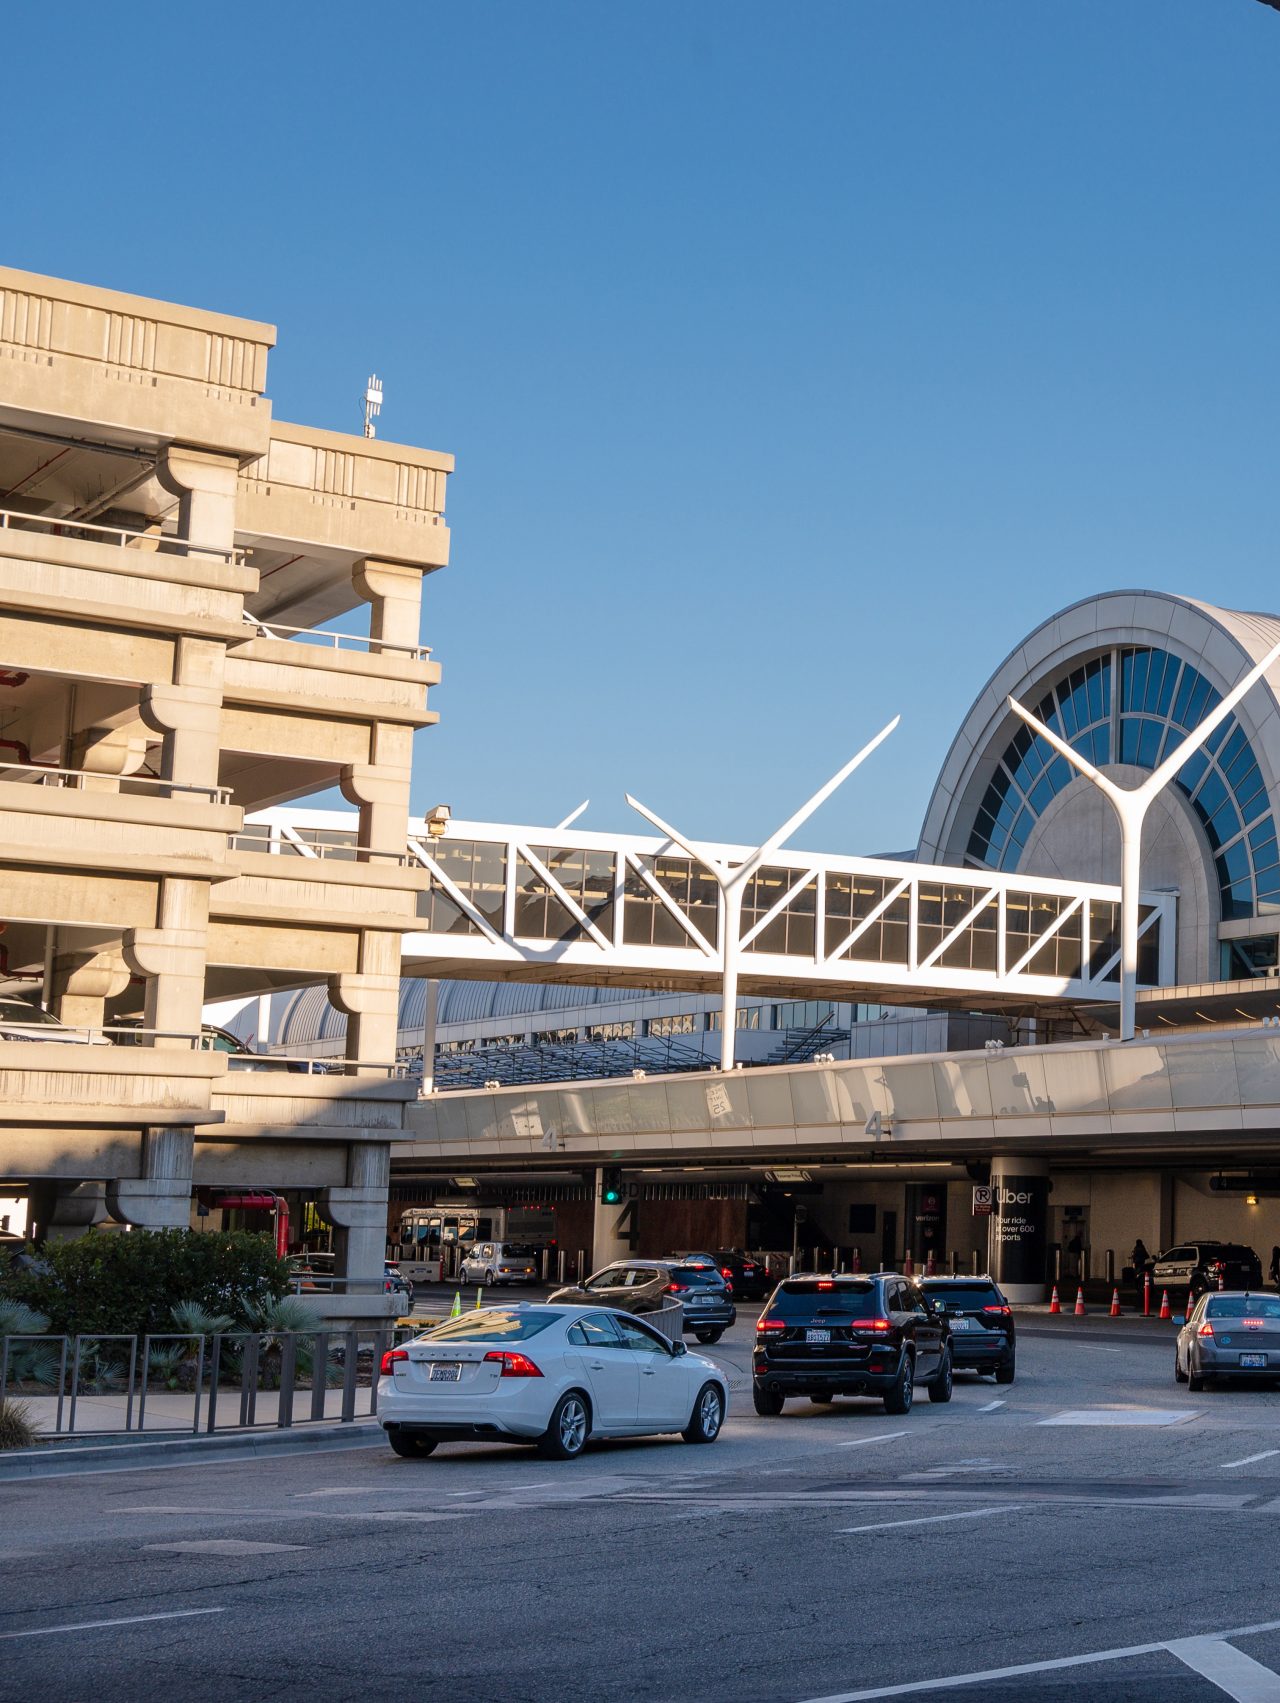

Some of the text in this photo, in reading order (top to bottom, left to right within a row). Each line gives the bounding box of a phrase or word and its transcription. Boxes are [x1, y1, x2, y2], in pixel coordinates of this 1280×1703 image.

[865, 1110, 882, 1142] 4
[541, 1126, 558, 1150] 4
[996, 1188, 1034, 1205] Uber
[610, 1199, 640, 1250] 4
[1011, 1216, 1027, 1225] ride
[1020, 1225, 1035, 1233] 600
